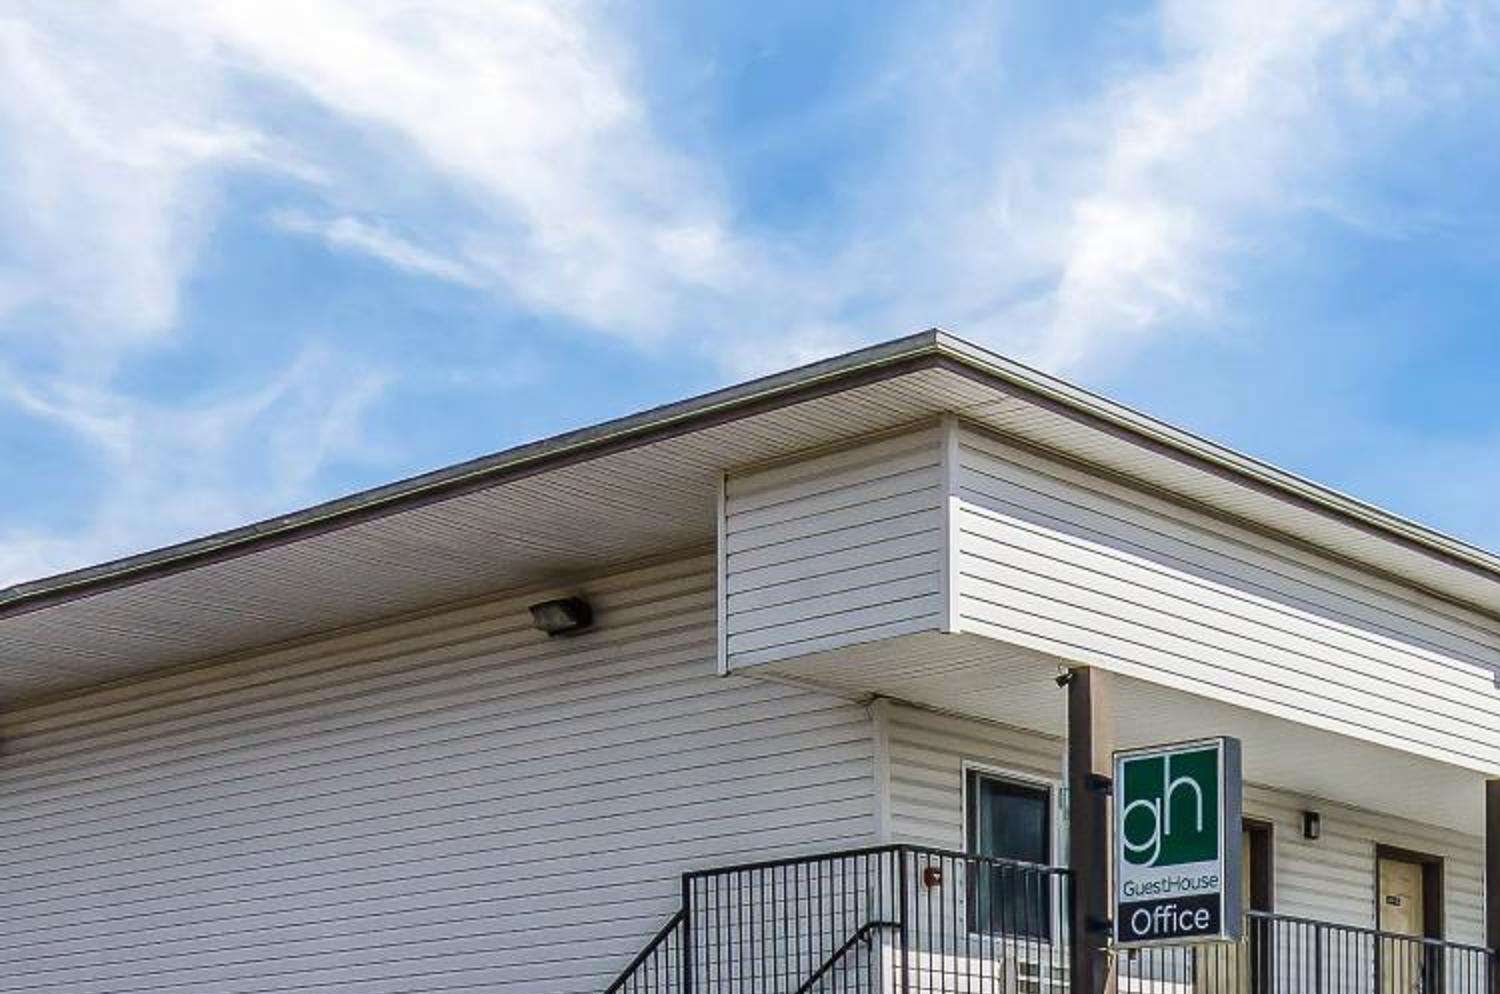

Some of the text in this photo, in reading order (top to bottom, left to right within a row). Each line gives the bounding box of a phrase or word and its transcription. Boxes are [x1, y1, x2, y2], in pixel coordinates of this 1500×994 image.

[1122, 754, 1203, 867] gh
[1123, 872, 1219, 897] GuestHouse
[1131, 903, 1210, 936] Office
